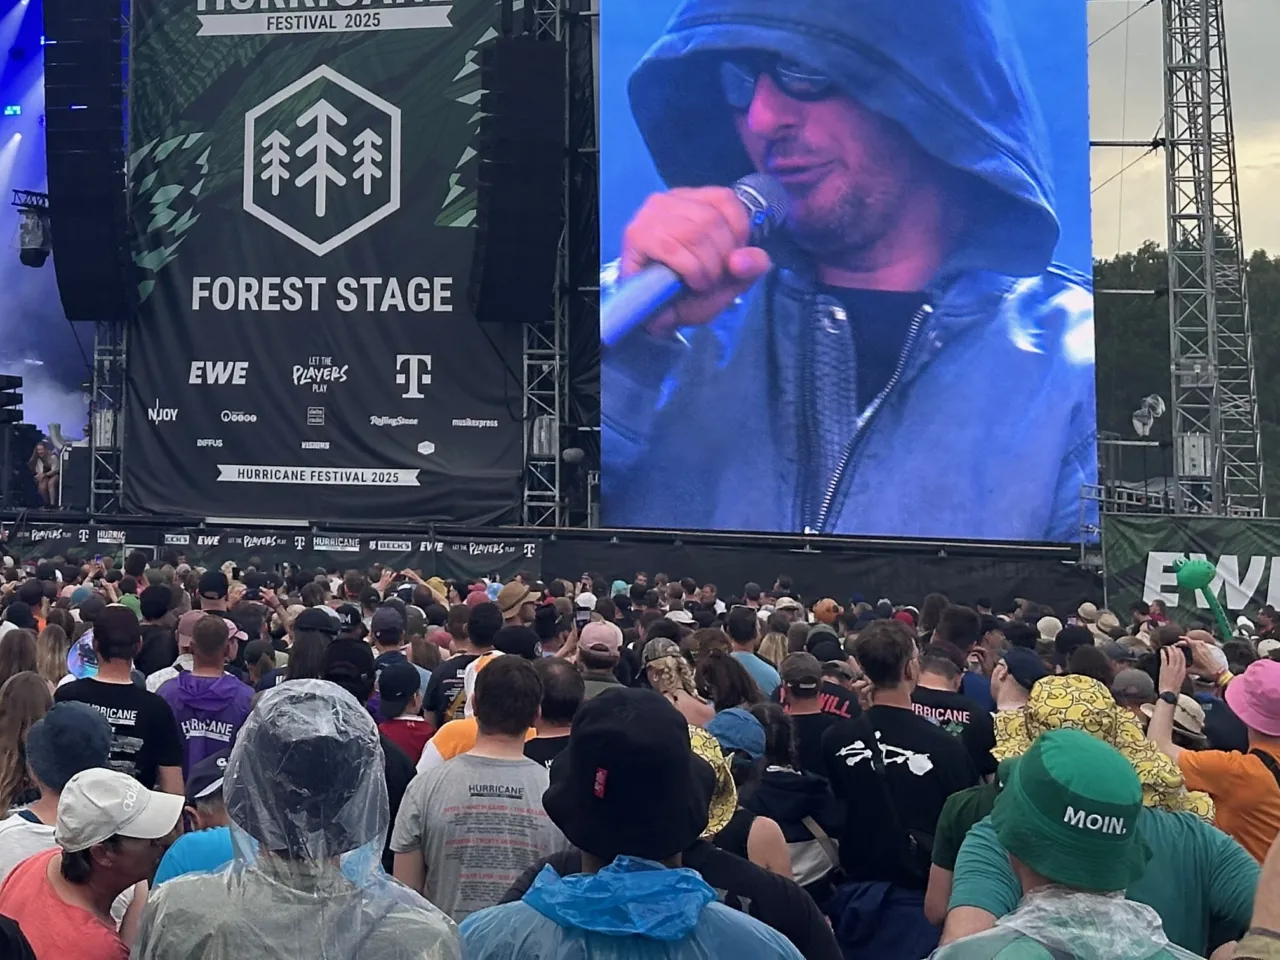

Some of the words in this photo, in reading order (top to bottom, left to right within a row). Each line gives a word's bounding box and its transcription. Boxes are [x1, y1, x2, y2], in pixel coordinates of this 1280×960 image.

[267, 14, 337, 31] FESTIVAL
[345, 12, 381, 28] 2025
[192, 276, 326, 312] FOREST
[337, 277, 453, 312] STAGE
[309, 357, 319, 365] LET
[321, 357, 332, 365] THE
[188, 361, 249, 384] EWE
[292, 365, 349, 386] PLAYERS
[312, 384, 327, 392] PLAY
[452, 418, 498, 428] musikexpress
[197, 439, 223, 447] DIFFUS
[237, 468, 306, 481] HURRICANE
[310, 471, 367, 482] FESTIVAL
[371, 472, 399, 483] 2025
[197, 536, 220, 545] EWE
[244, 535, 276, 547] PLAYERS
[313, 537, 360, 547] HURRICANE
[469, 542, 504, 555] PLAYERS
[469, 784, 524, 796] HURRICANE
